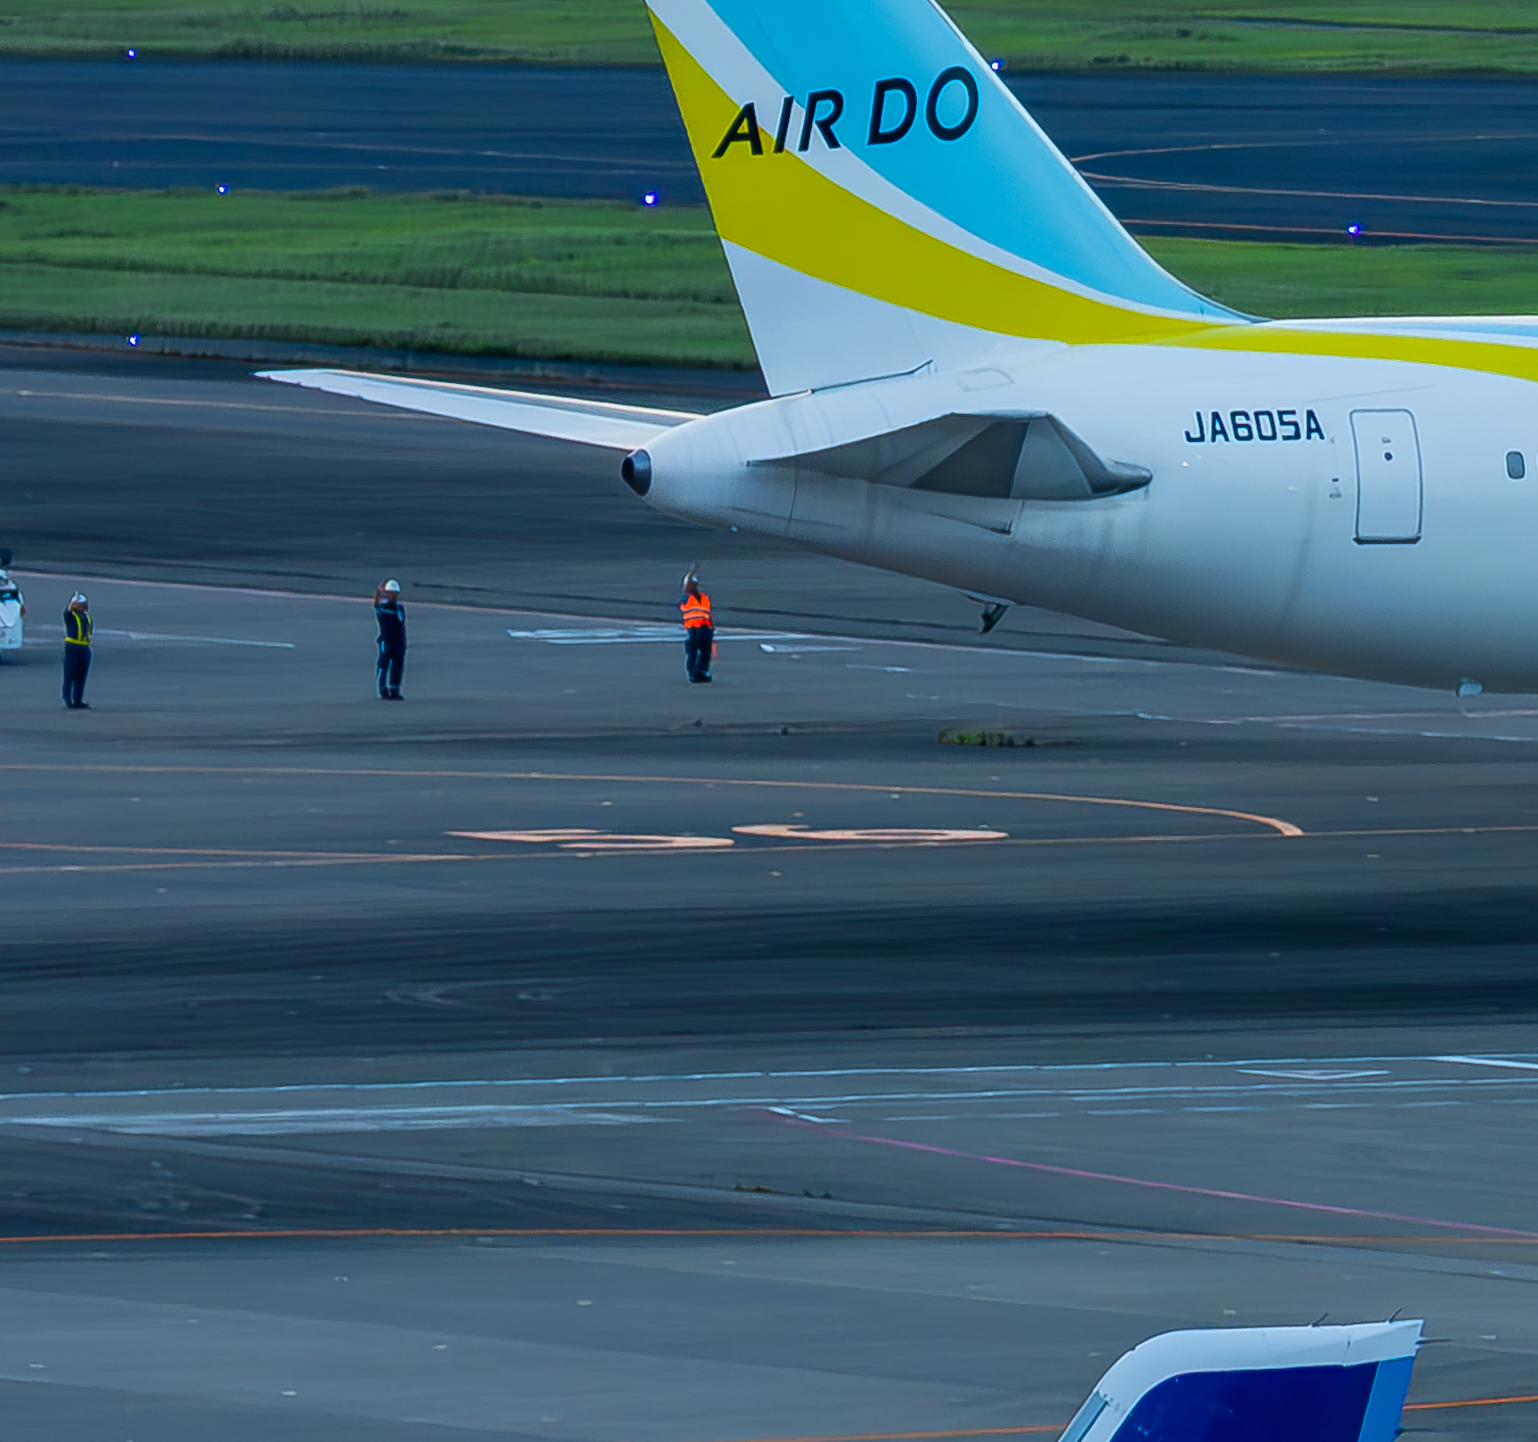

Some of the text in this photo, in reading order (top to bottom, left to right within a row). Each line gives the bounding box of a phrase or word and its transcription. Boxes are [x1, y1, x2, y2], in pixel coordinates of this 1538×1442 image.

[711, 66, 979, 158] AIR DO
[1184, 409, 1326, 443] JA605A
